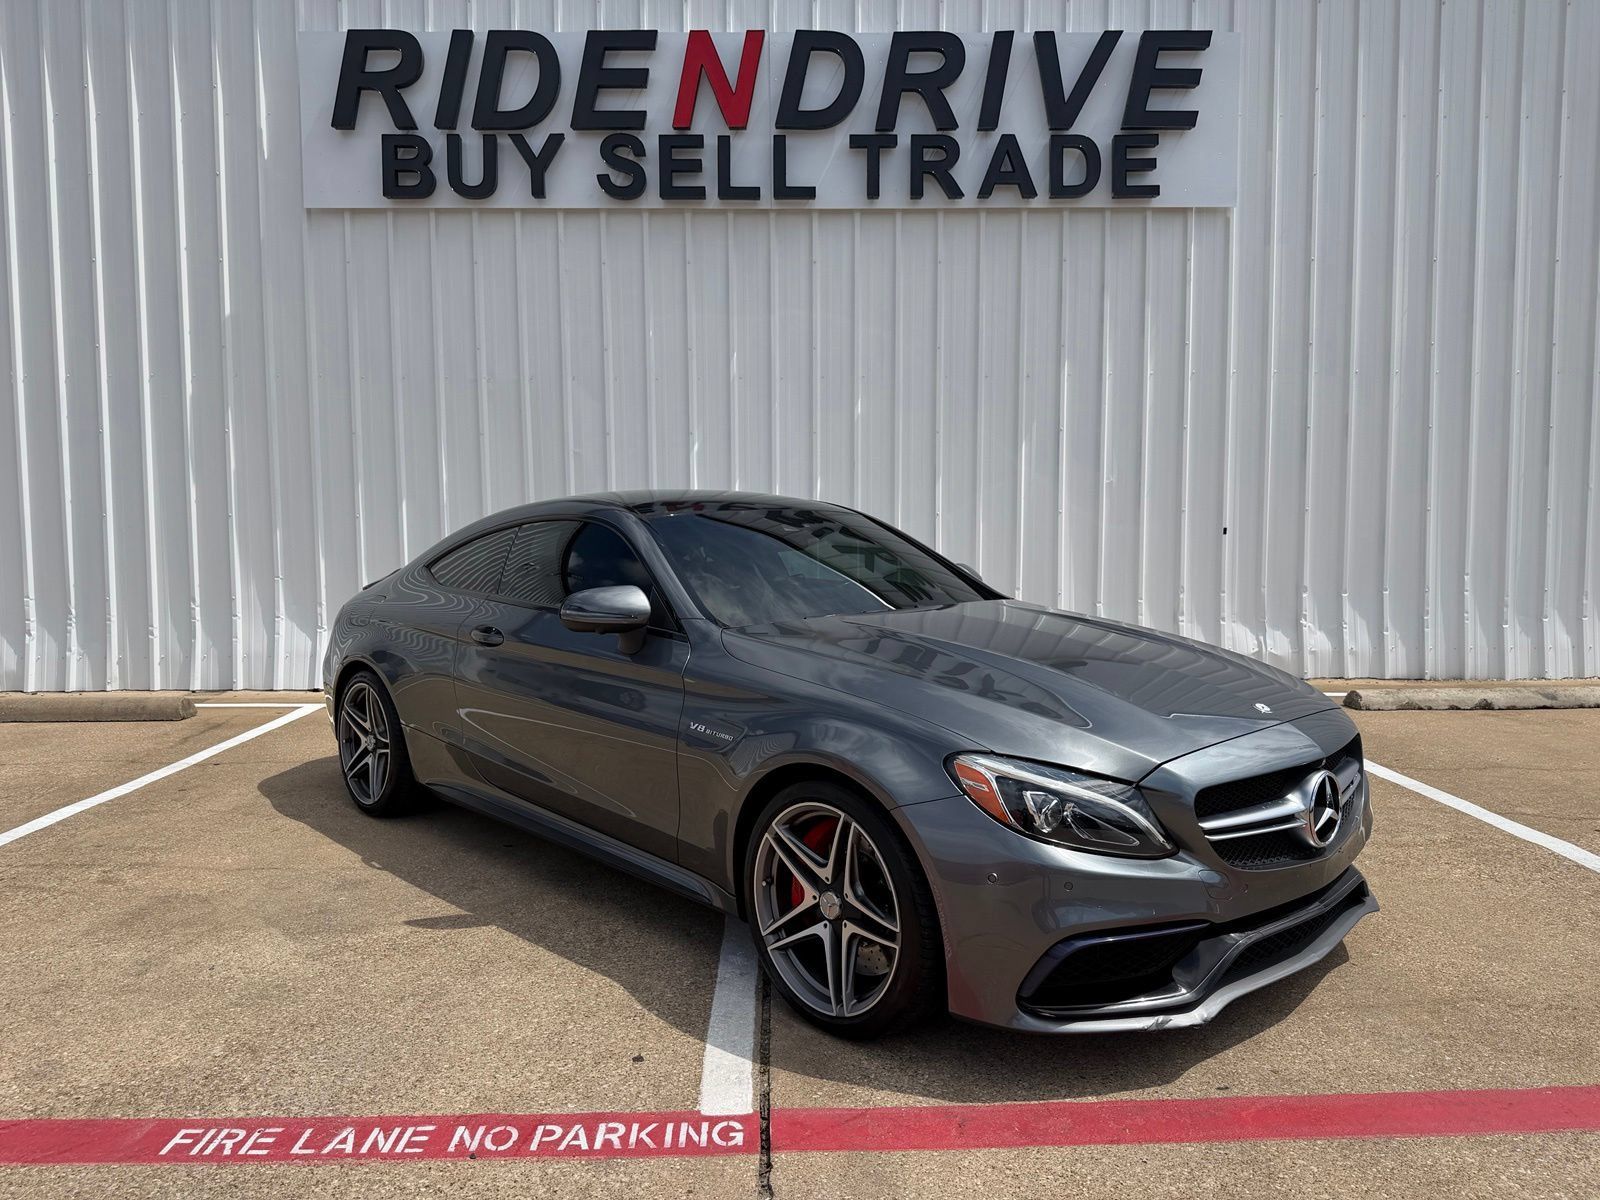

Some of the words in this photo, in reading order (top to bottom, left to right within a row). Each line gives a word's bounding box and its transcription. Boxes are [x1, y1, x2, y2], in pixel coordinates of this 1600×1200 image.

[331, 29, 1213, 131] RIDENDRIVE
[381, 133, 565, 199] BUY
[596, 132, 816, 200] SELL
[849, 133, 1160, 200] TRADE
[690, 721, 706, 732] V8
[705, 729, 734, 742] BITURBO
[158, 1127, 287, 1156] FIRE
[289, 1124, 436, 1155] LANE
[447, 1124, 518, 1153] NO
[529, 1120, 745, 1151] PARKING
